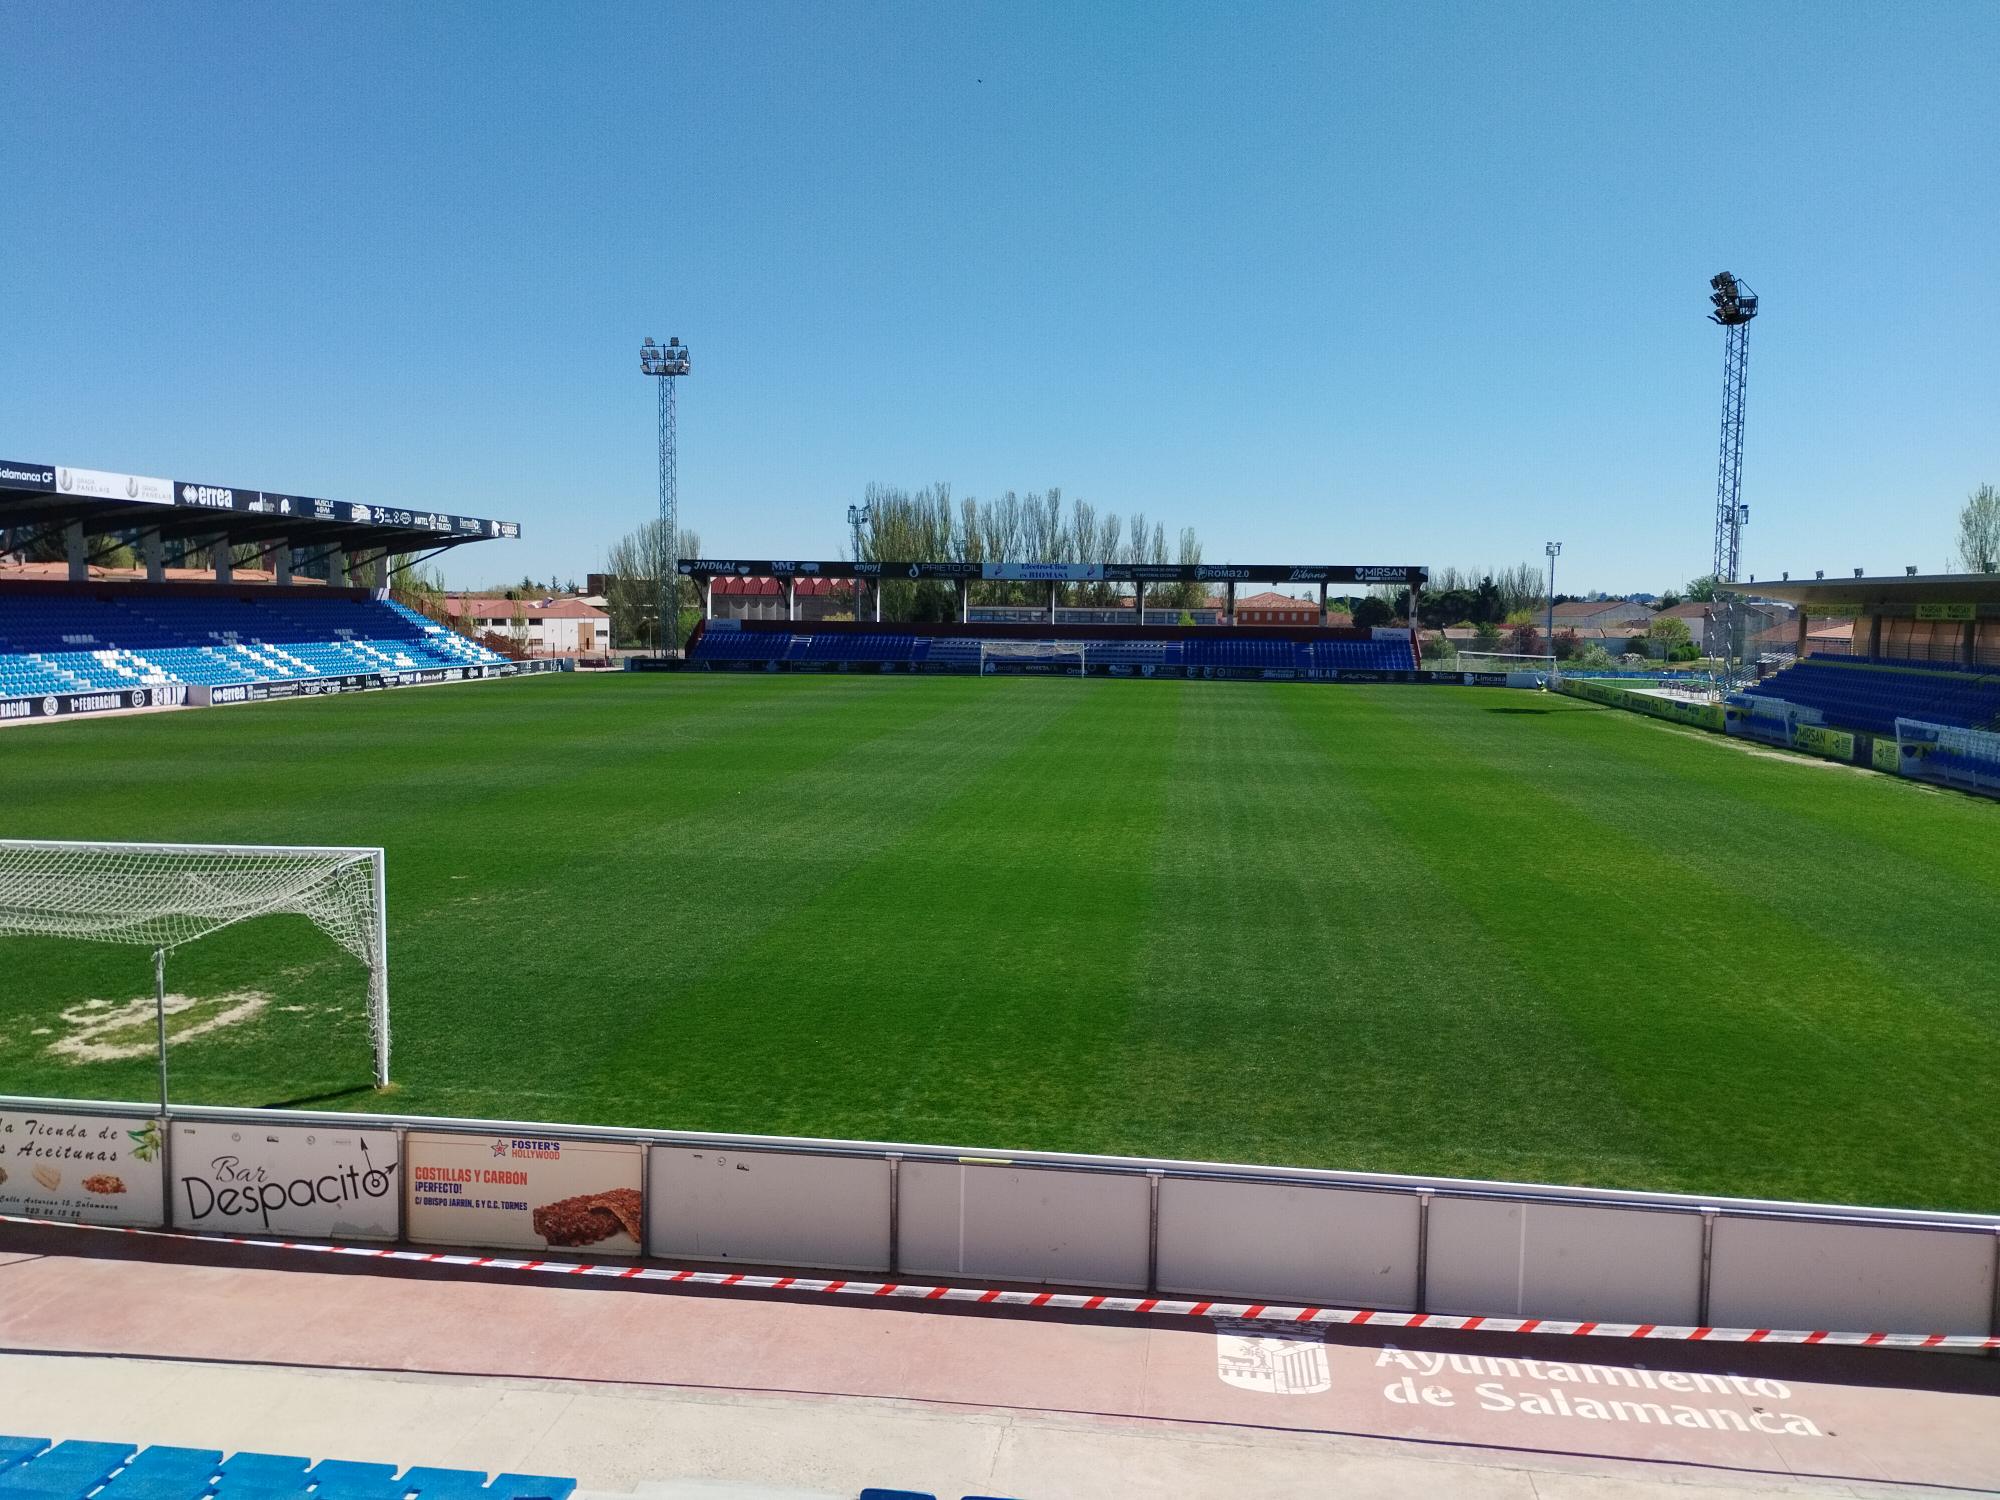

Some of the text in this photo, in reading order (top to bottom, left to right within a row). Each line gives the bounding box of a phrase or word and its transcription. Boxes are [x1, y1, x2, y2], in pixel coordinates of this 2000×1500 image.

[42, 472, 53, 483] CF
[374, 508, 384, 524] 25
[853, 563, 881, 573] enjoy!
[921, 564, 980, 573] PRIETO OIL
[1307, 669, 1338, 678] MILAR
[0, 700, 31, 717] RACIÓN
[79, 693, 121, 711] FEDERACIÓN
[25, 1119, 87, 1138] Tienda
[98, 1126, 118, 1140] de
[17, 1140, 118, 1162] Aceitunas
[511, 1140, 560, 1151] FOSTER'S
[511, 1149, 560, 1160] HOLLYWOOD
[211, 1155, 268, 1182] Bar
[415, 1166, 472, 1183] COSTILLAS
[473, 1169, 481, 1183] Y
[415, 1181, 462, 1194] ¡PERFECTO!
[181, 1164, 389, 1229] Despacito
[415, 1196, 422, 1205] C/
[423, 1196, 448, 1207] OBISPO
[481, 1200, 487, 1209] Y
[501, 1201, 528, 1211] TORMES
[1374, 1341, 1792, 1401] Ayuntamiento
[1383, 1374, 1824, 1438] de Salamanca
